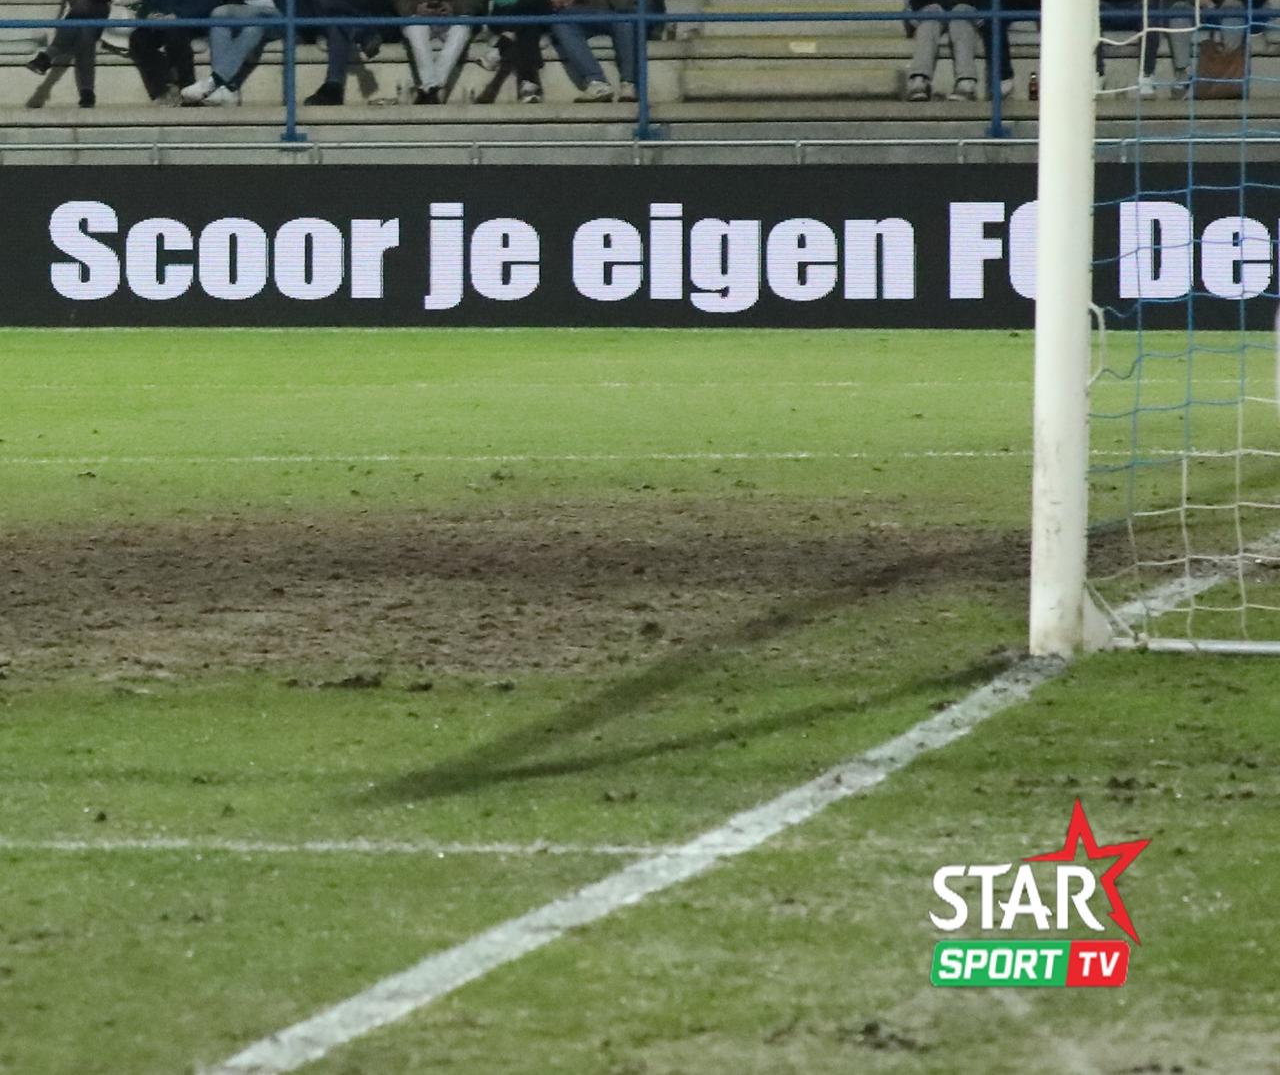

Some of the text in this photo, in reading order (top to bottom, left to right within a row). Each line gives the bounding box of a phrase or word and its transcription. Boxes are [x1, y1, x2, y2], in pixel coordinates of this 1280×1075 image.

[50, 201, 399, 300] Scoor
[424, 202, 541, 310] je
[572, 202, 915, 313] eigen
[1119, 201, 1280, 299] De
